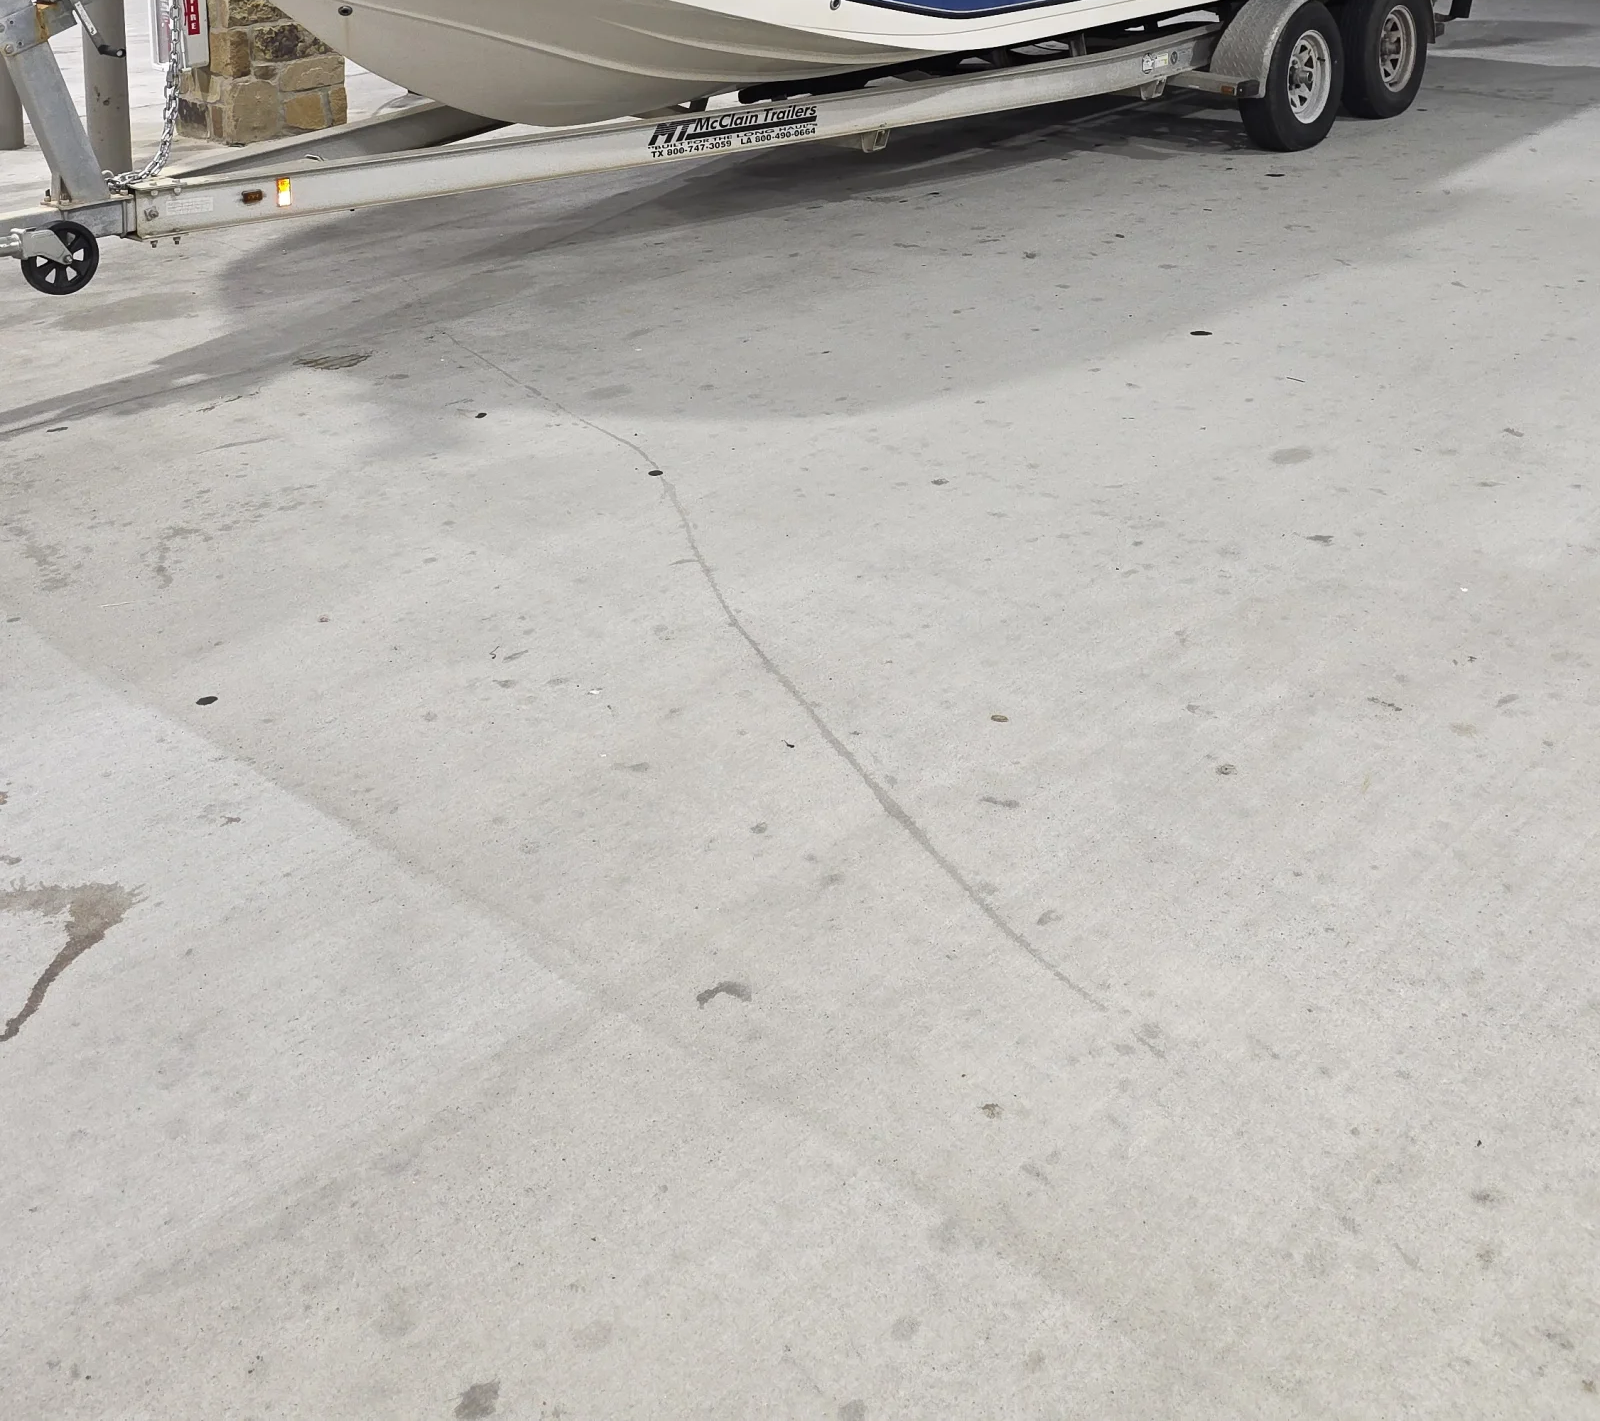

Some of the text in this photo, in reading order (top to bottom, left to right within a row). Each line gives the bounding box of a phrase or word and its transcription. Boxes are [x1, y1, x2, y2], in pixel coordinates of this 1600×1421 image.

[648, 105, 817, 146] MT McClain Trailers
[736, 129, 775, 138] LONG
[651, 128, 816, 158] TX 800-747-3059 LA 800-490-0664
